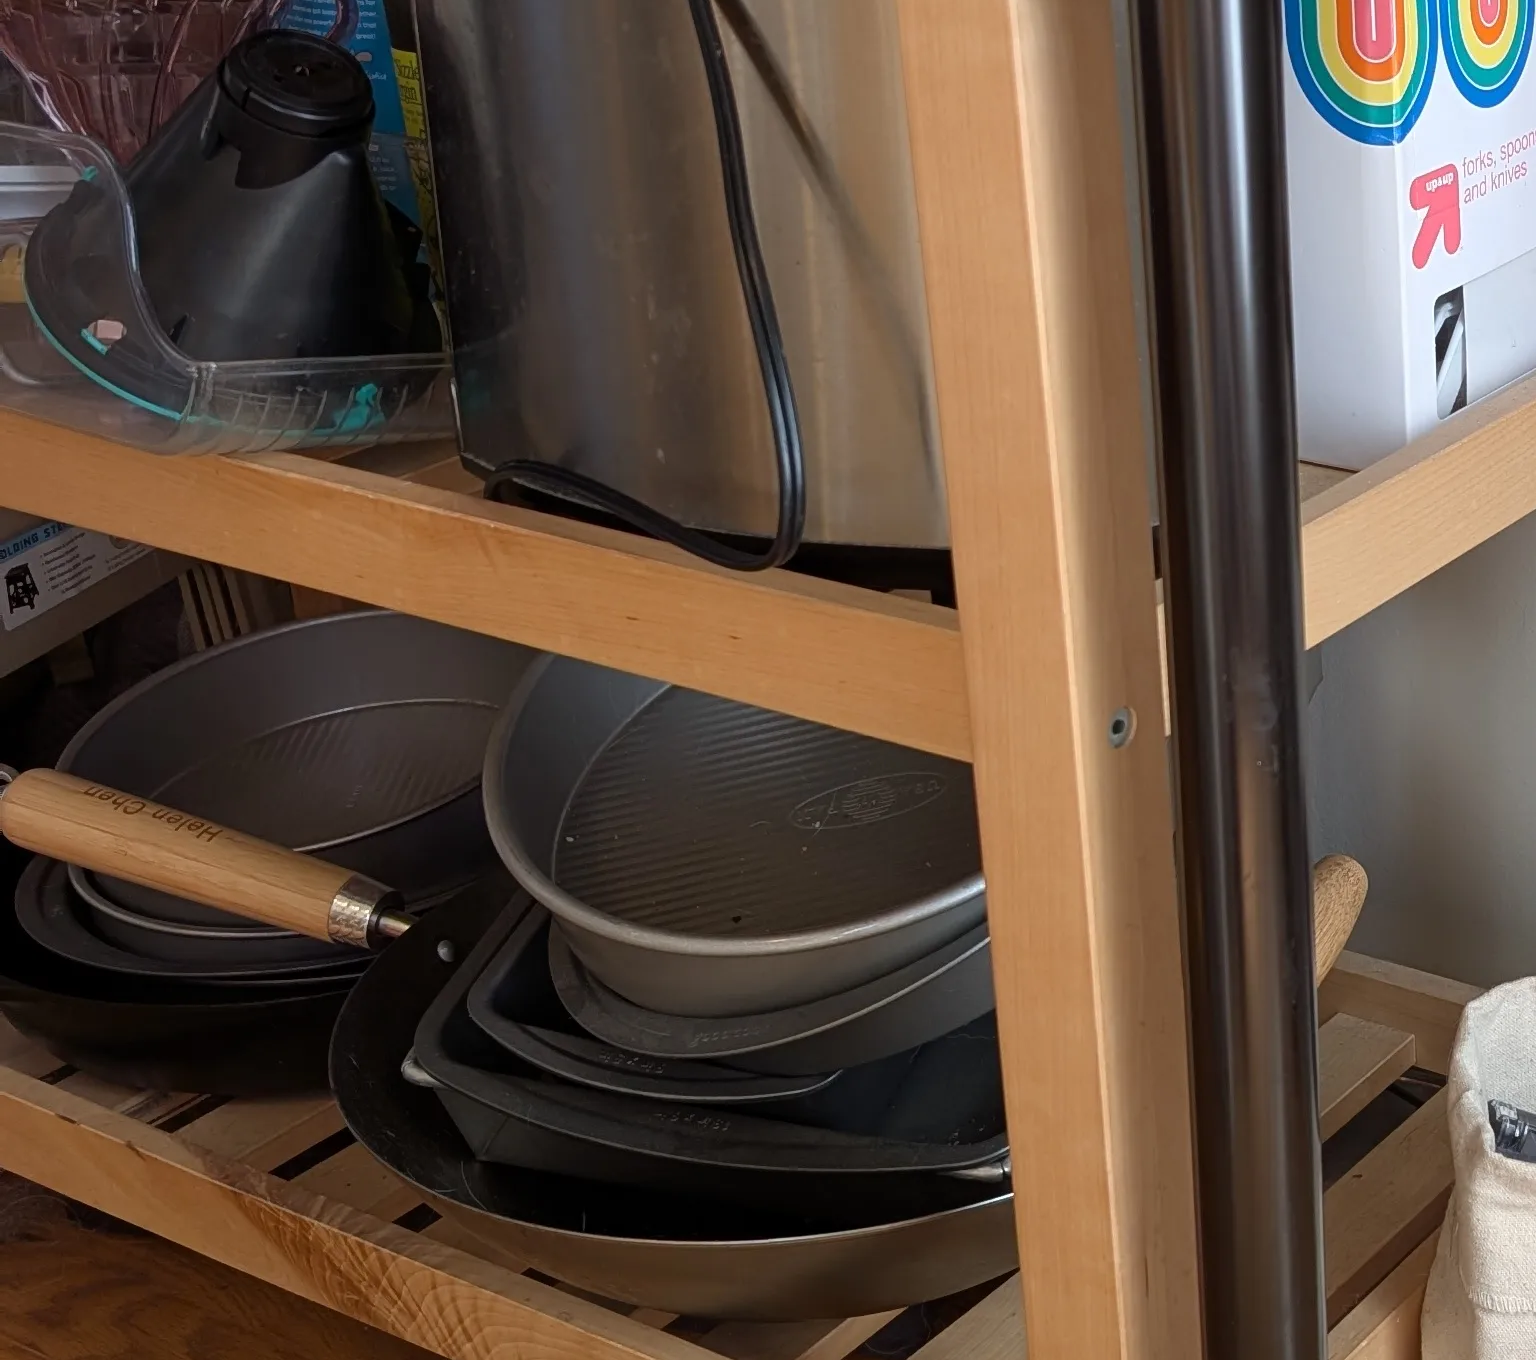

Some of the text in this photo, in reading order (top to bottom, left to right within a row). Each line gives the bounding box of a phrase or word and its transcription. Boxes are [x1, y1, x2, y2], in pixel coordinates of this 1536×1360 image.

[1462, 150, 1497, 178] forks,
[1425, 173, 1454, 192] up&up
[1463, 161, 1528, 204] and knives
[83, 786, 224, 843] Helen Chen
